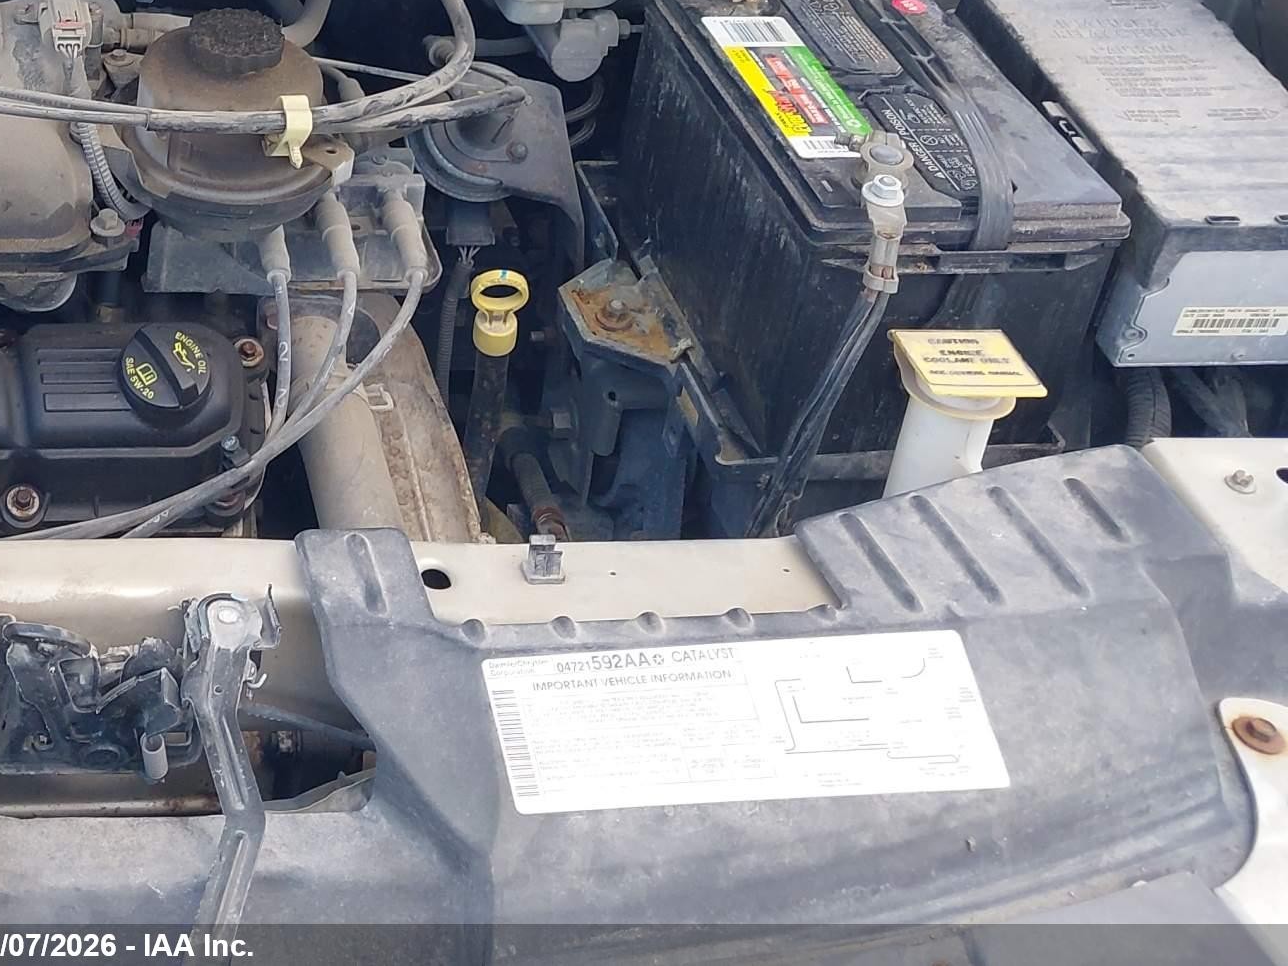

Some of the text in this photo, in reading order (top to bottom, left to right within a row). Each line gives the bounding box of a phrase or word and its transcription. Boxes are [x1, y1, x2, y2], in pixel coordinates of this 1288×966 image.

[881, 109, 909, 138] POISON
[908, 141, 939, 172] DANGER
[175, 331, 207, 375] ENGINE OIL
[278, 341, 289, 362] 2
[125, 357, 136, 375] SAE
[556, 647, 734, 673] 04721592AA CATALYST
[532, 669, 732, 691] IMPORTANT VEHICLE INFORMATION
